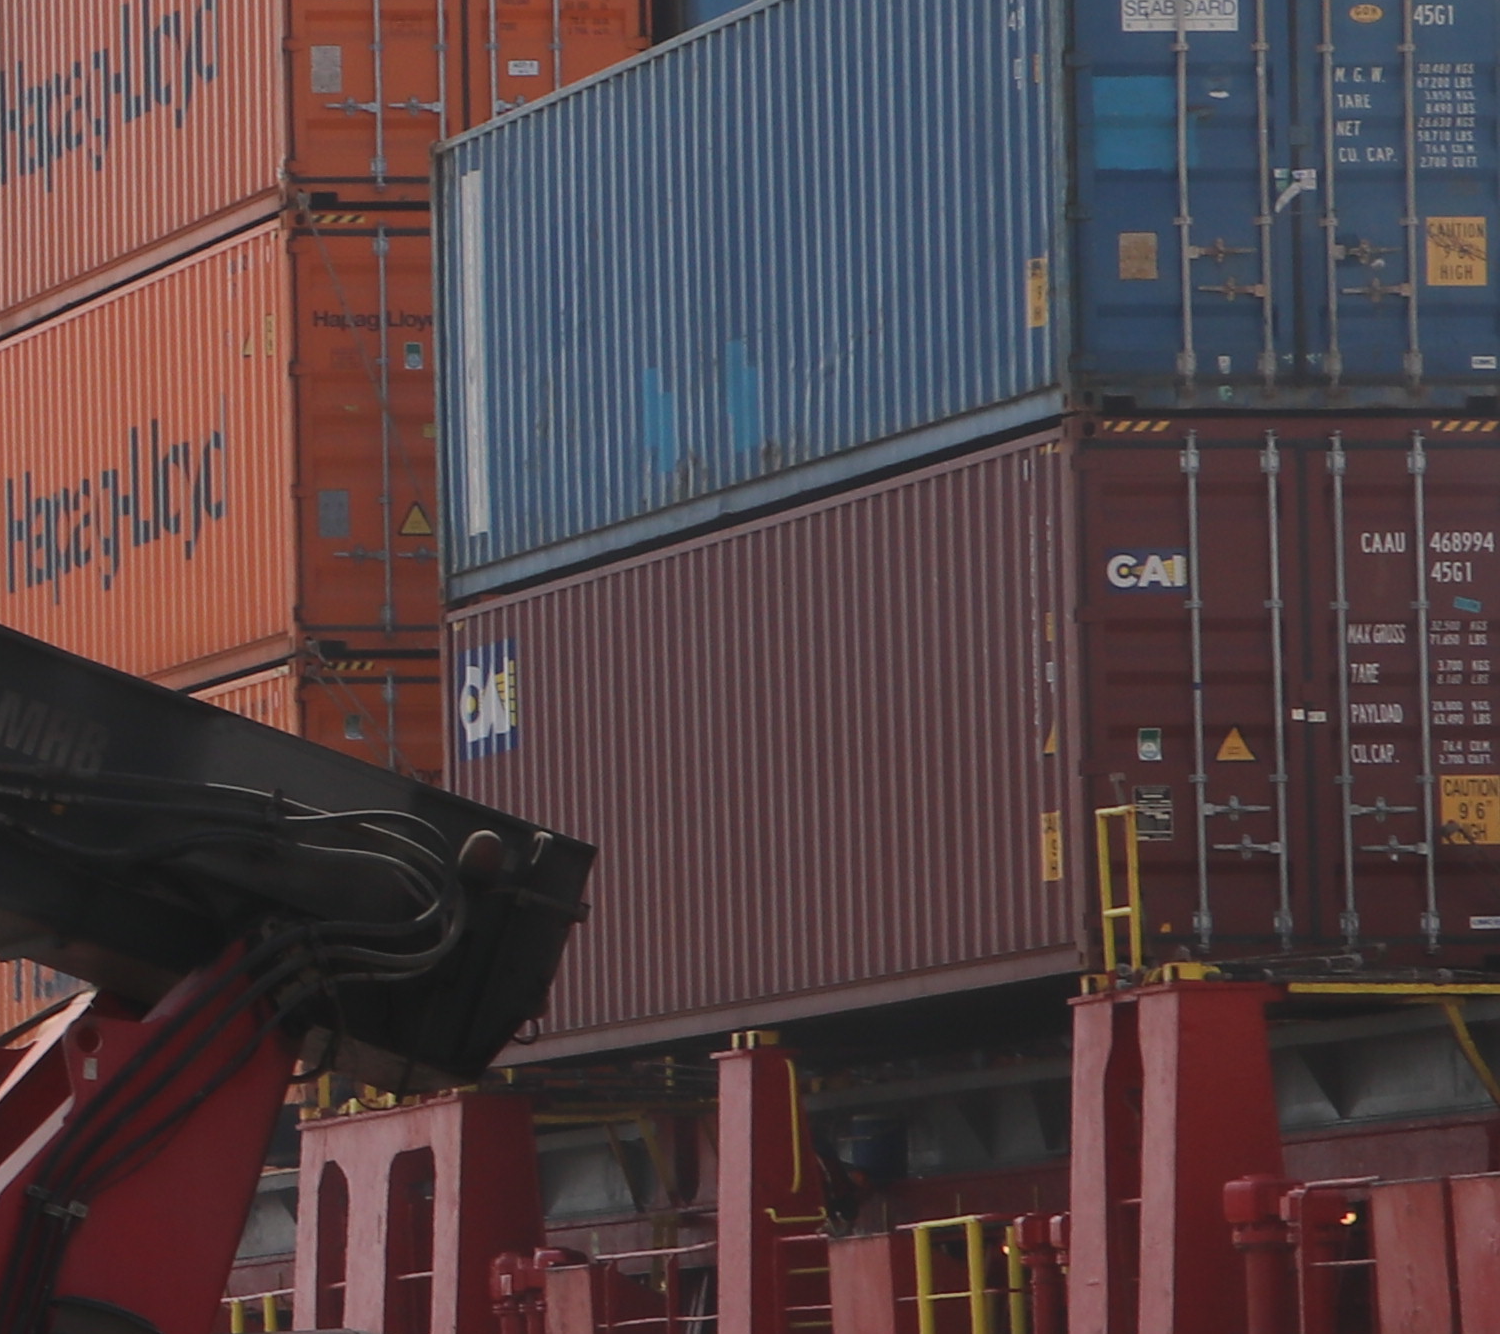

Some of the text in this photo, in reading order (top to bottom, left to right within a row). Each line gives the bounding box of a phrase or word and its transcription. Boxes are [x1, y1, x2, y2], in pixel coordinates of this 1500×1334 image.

[1413, 4, 1454, 26] 45G1
[1336, 93, 1372, 109] TARE
[1336, 120, 1362, 136] NET
[1440, 265, 1474, 280] HIGH
[1361, 531, 1495, 554] CAAU 468994
[1107, 554, 1186, 588] CAI
[1430, 561, 1473, 583] 45G1
[1347, 623, 1406, 644] MAX GROSS
[1350, 663, 1380, 684] TARE
[1350, 703, 1403, 724] PAYLOAD
[1444, 778, 1499, 797] CAUTION
